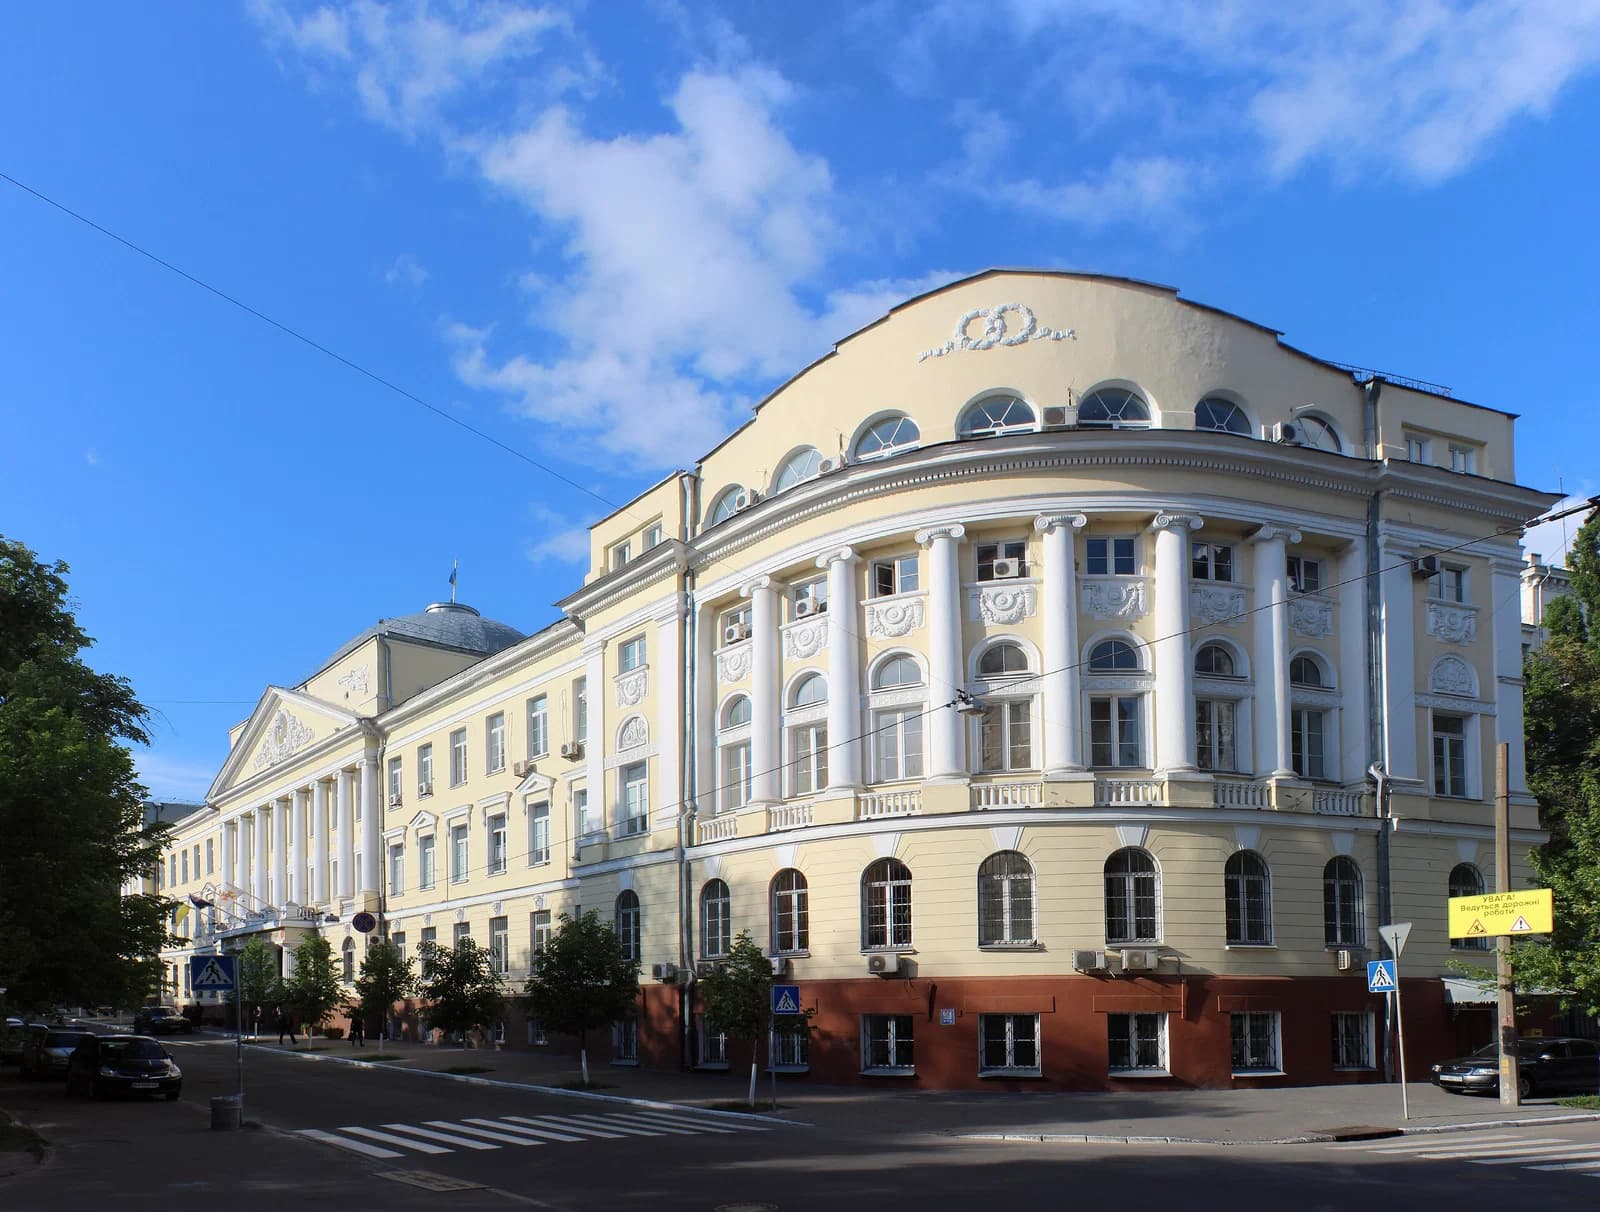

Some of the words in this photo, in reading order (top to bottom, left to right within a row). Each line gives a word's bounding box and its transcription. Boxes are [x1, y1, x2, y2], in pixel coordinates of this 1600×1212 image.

[1483, 894, 1515, 903] УВАГА!
[1460, 903, 1500, 912] Ведуться
[1502, 899, 1540, 909] дорожні
[1484, 909, 1515, 917] роботи
